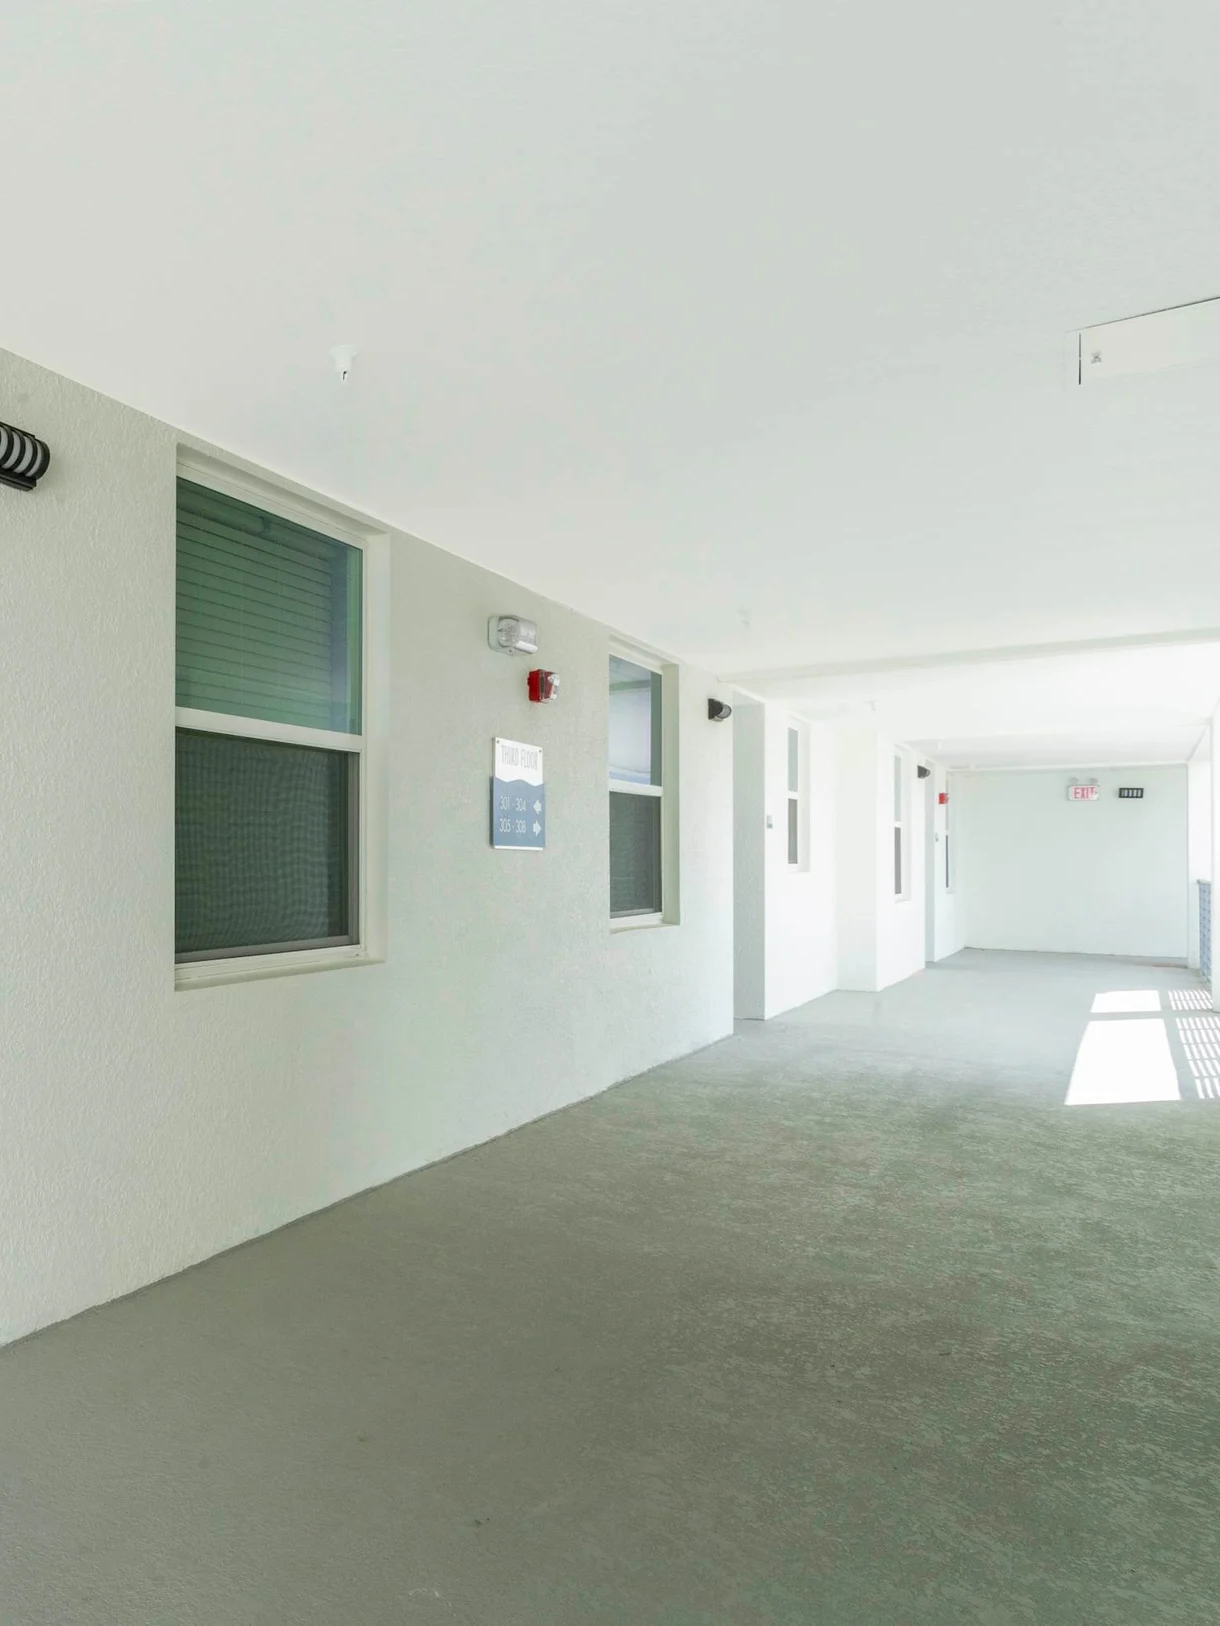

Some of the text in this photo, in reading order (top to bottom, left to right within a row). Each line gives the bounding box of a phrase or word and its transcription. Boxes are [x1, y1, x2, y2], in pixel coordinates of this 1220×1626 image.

[500, 745, 538, 770] THIRD FLOOR
[1074, 787, 1095, 799] EXIT
[500, 796, 510, 810] 301
[515, 797, 526, 812] 304
[499, 818, 510, 832] 305
